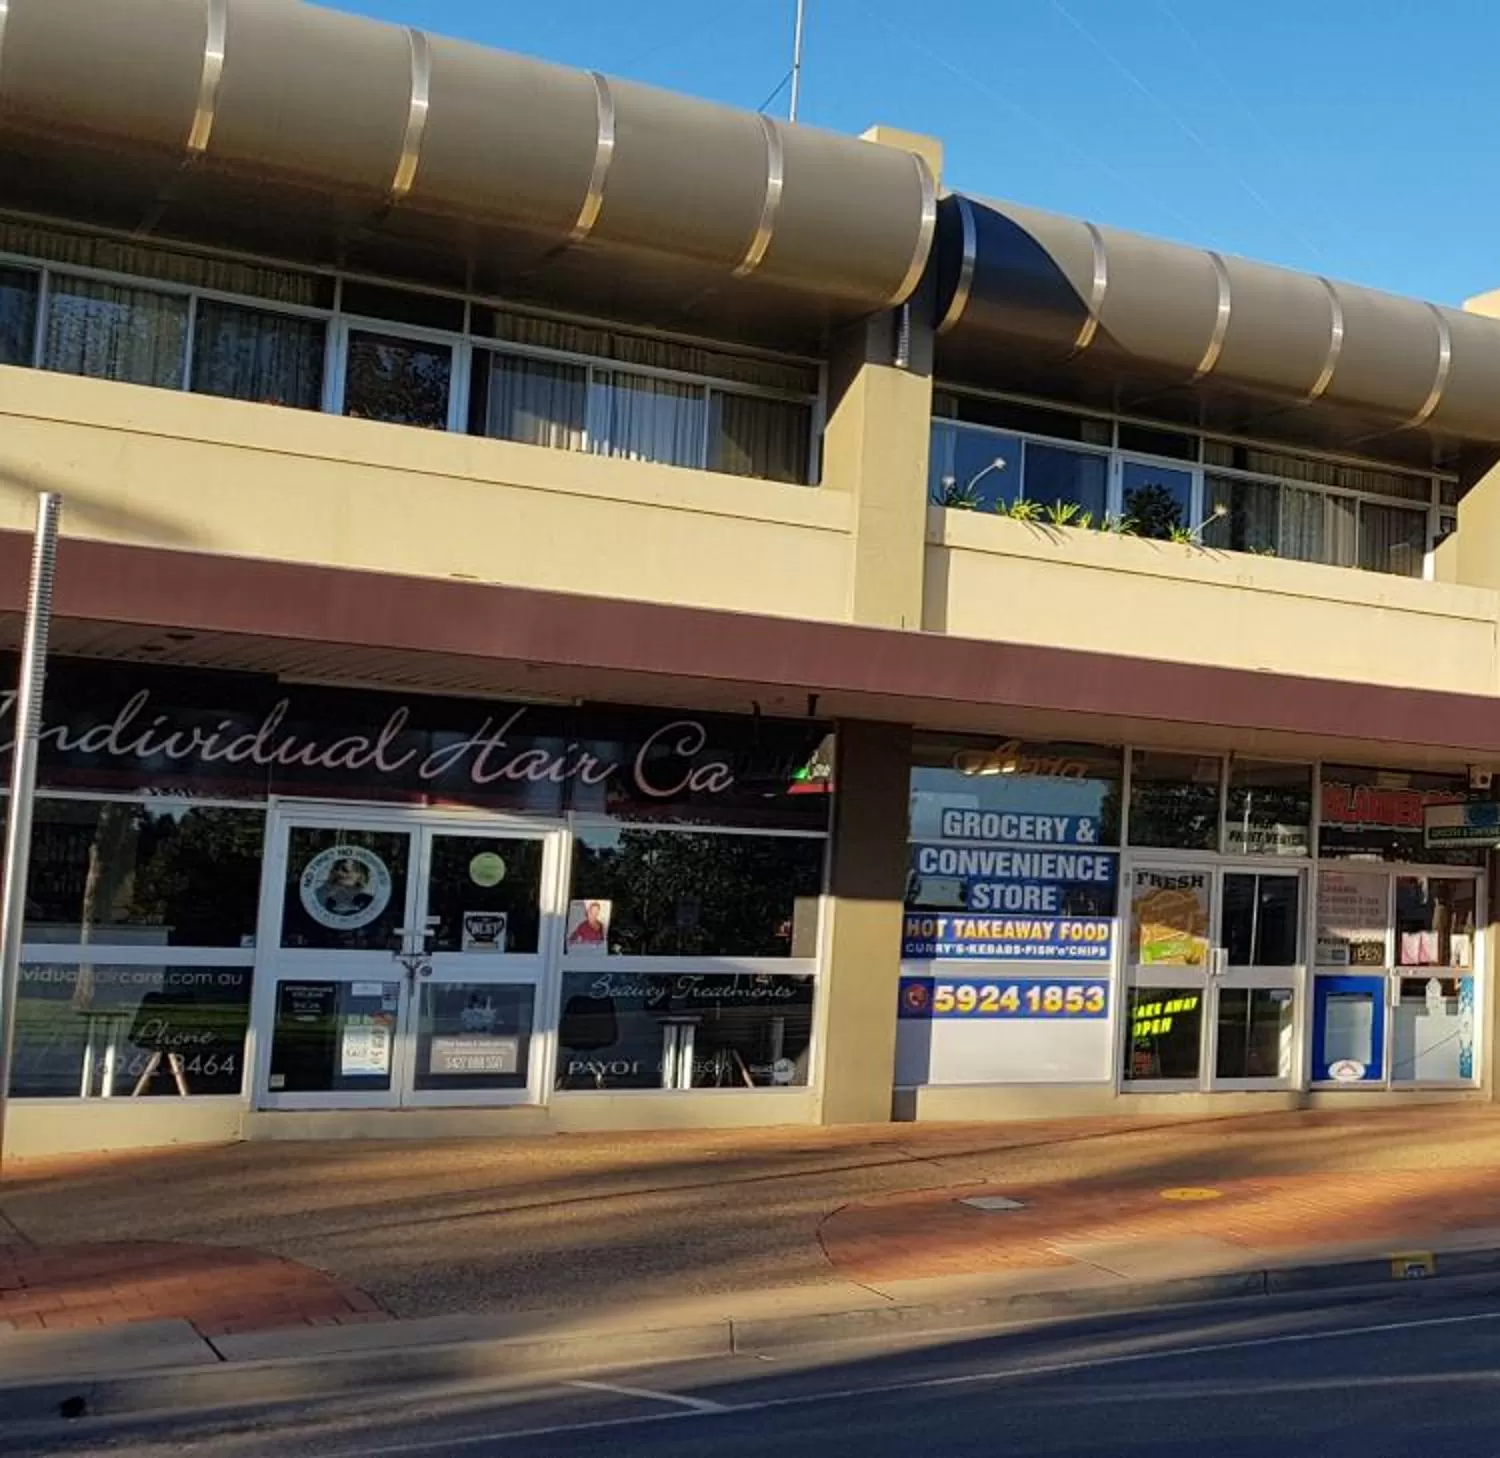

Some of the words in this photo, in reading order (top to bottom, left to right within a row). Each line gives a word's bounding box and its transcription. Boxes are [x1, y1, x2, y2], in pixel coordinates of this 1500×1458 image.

[419, 706, 619, 784] Hair
[634, 720, 735, 797] Ca
[943, 810, 1069, 842] GROCERY
[1075, 818, 1095, 842] &
[919, 848, 1111, 881] CONVENIENCE
[1136, 871, 1204, 889] FRESH
[971, 883, 1057, 911] STORE
[906, 918, 947, 938] HOT
[953, 919, 1055, 939] TAKEAWAY
[1060, 921, 1109, 940] FOOD
[934, 985, 1020, 1013] 5924
[1026, 985, 1105, 1013] 1853
[1163, 997, 1199, 1014] AWAY
[1132, 1017, 1173, 1036] OPEN
[568, 1061, 642, 1075] PAYOT
